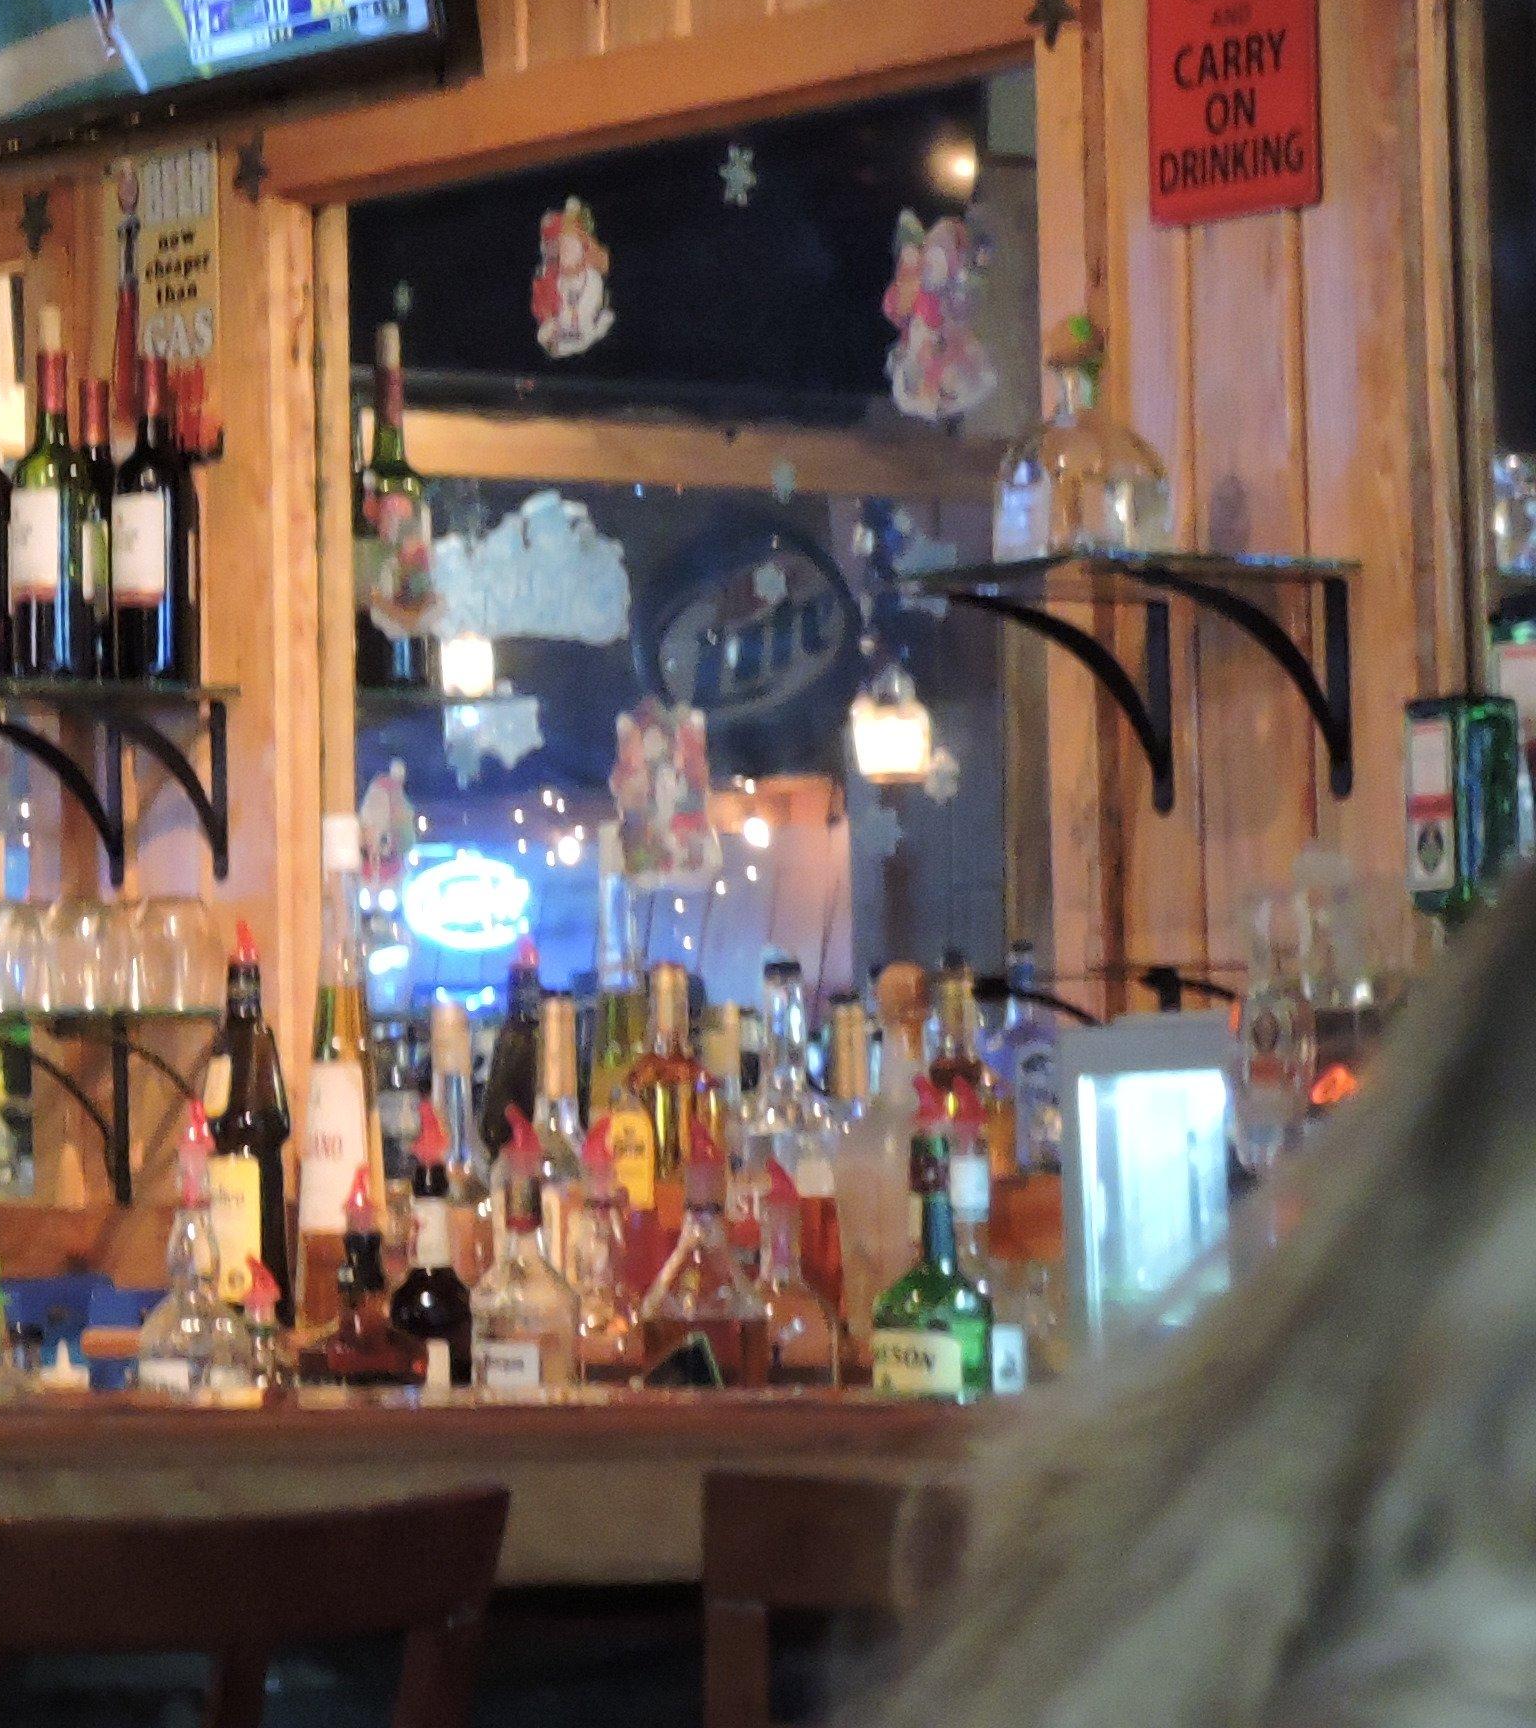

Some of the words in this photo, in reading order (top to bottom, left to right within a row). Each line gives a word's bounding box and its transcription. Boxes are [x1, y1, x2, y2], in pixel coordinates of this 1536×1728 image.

[1172, 28, 1288, 91] CARRY
[1204, 87, 1258, 136] ON
[1159, 130, 1306, 197] DRINKING
[143, 305, 215, 360] GAS
